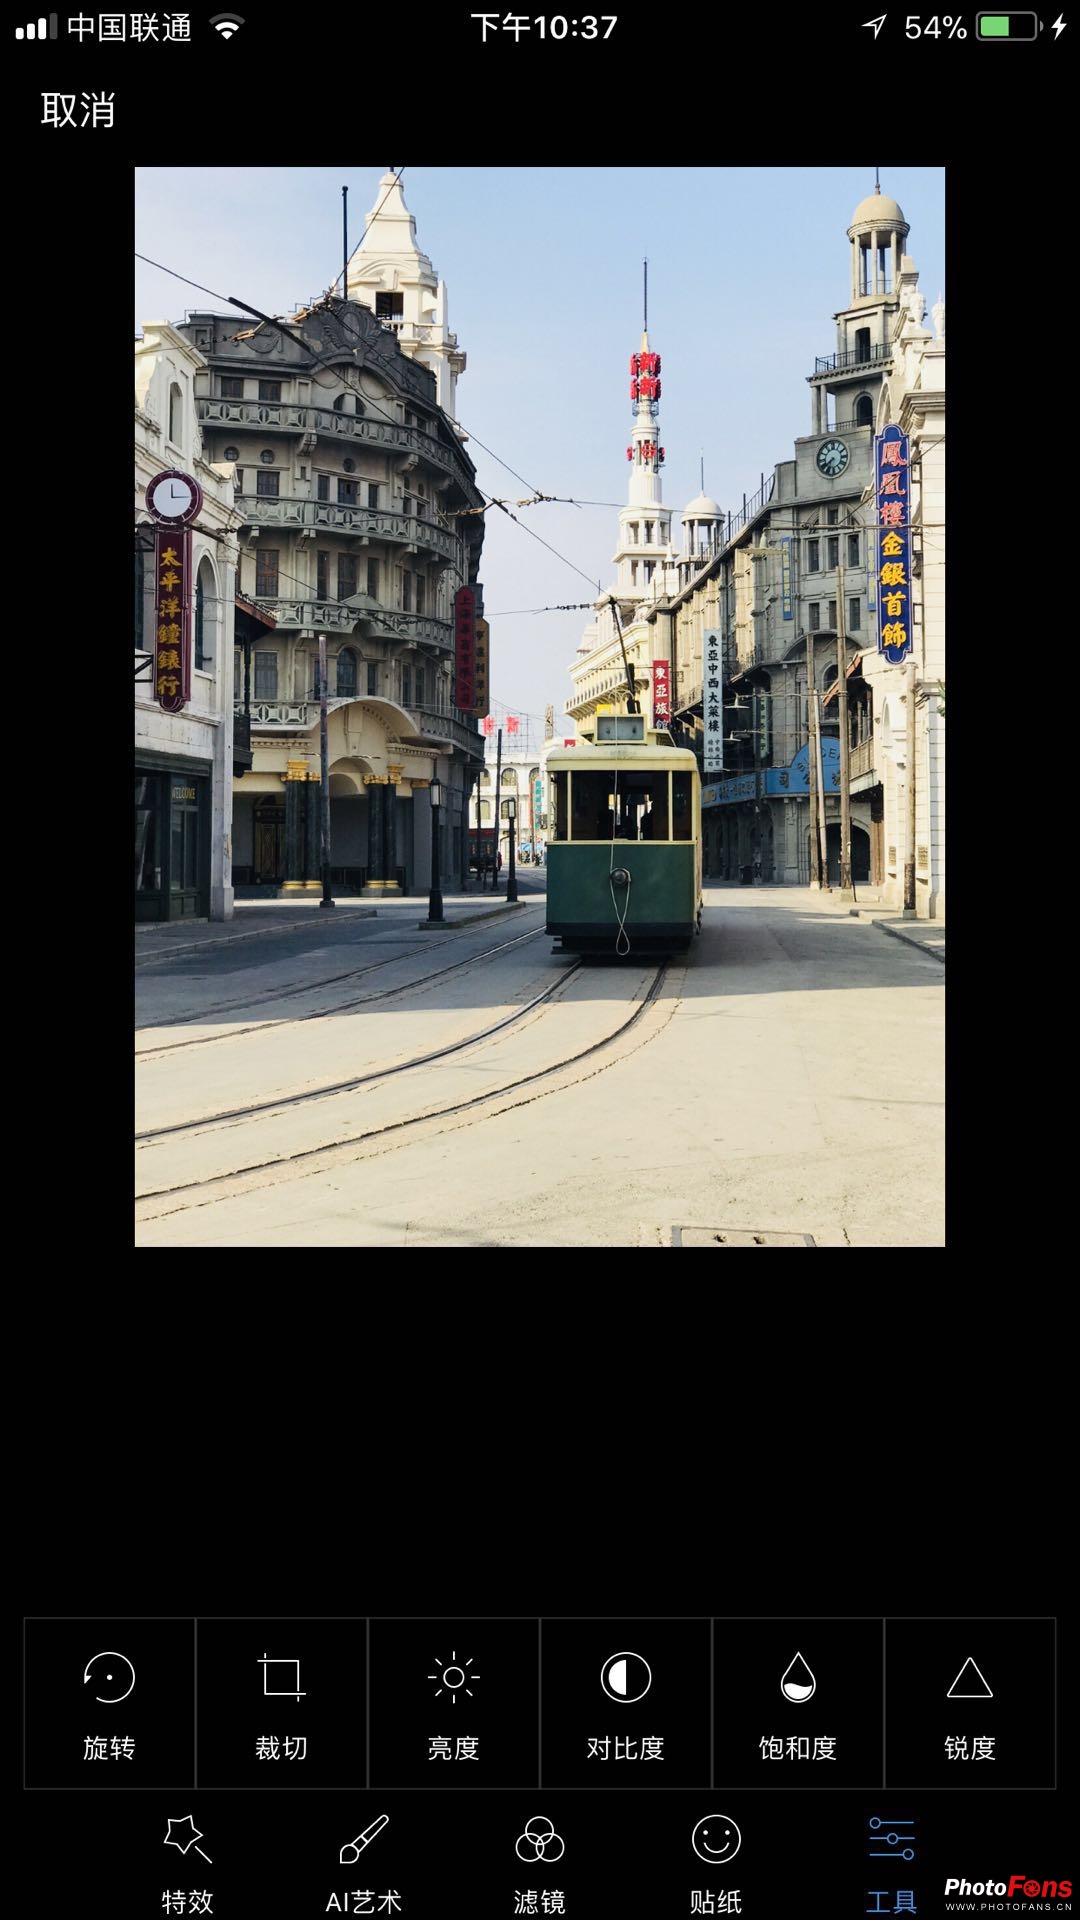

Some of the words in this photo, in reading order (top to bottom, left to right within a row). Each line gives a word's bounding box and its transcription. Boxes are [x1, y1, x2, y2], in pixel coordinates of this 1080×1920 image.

[67, 12, 192, 43] 中国联通
[470, 12, 618, 43] 下午10:37
[905, 16, 968, 40] 54%
[40, 90, 116, 129] 取消
[83, 1735, 136, 1761] 旋转
[255, 1735, 307, 1761] 裁切
[428, 1735, 480, 1761] 亮度
[586, 1735, 665, 1761] 对比度
[758, 1735, 837, 1761] 饱和度
[944, 1735, 996, 1761] 锐度
[161, 1889, 214, 1915] 特效
[324, 1888, 402, 1915] AI艺术
[513, 1888, 566, 1915] 滤镜
[690, 1889, 743, 1915] 贴纸
[865, 1889, 918, 1915] 工具
